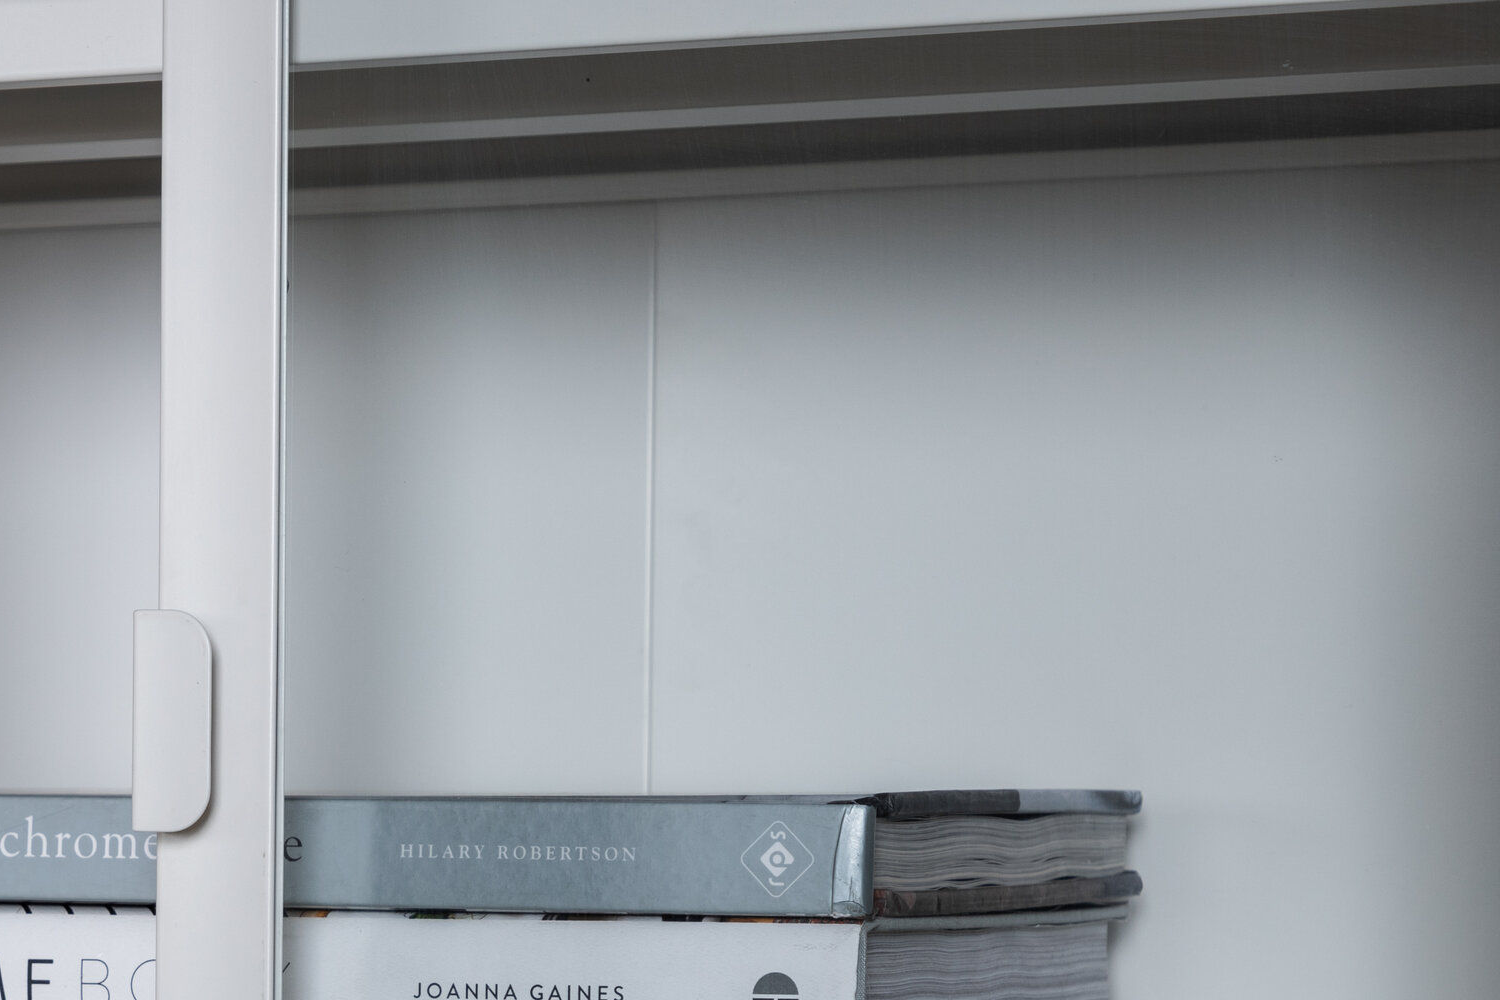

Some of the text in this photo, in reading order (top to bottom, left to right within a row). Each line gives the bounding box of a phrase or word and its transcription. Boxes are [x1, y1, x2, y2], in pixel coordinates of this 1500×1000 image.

[400, 843, 636, 862] HILARY ROBERTSON
[413, 982, 518, 1000] JOANNA
